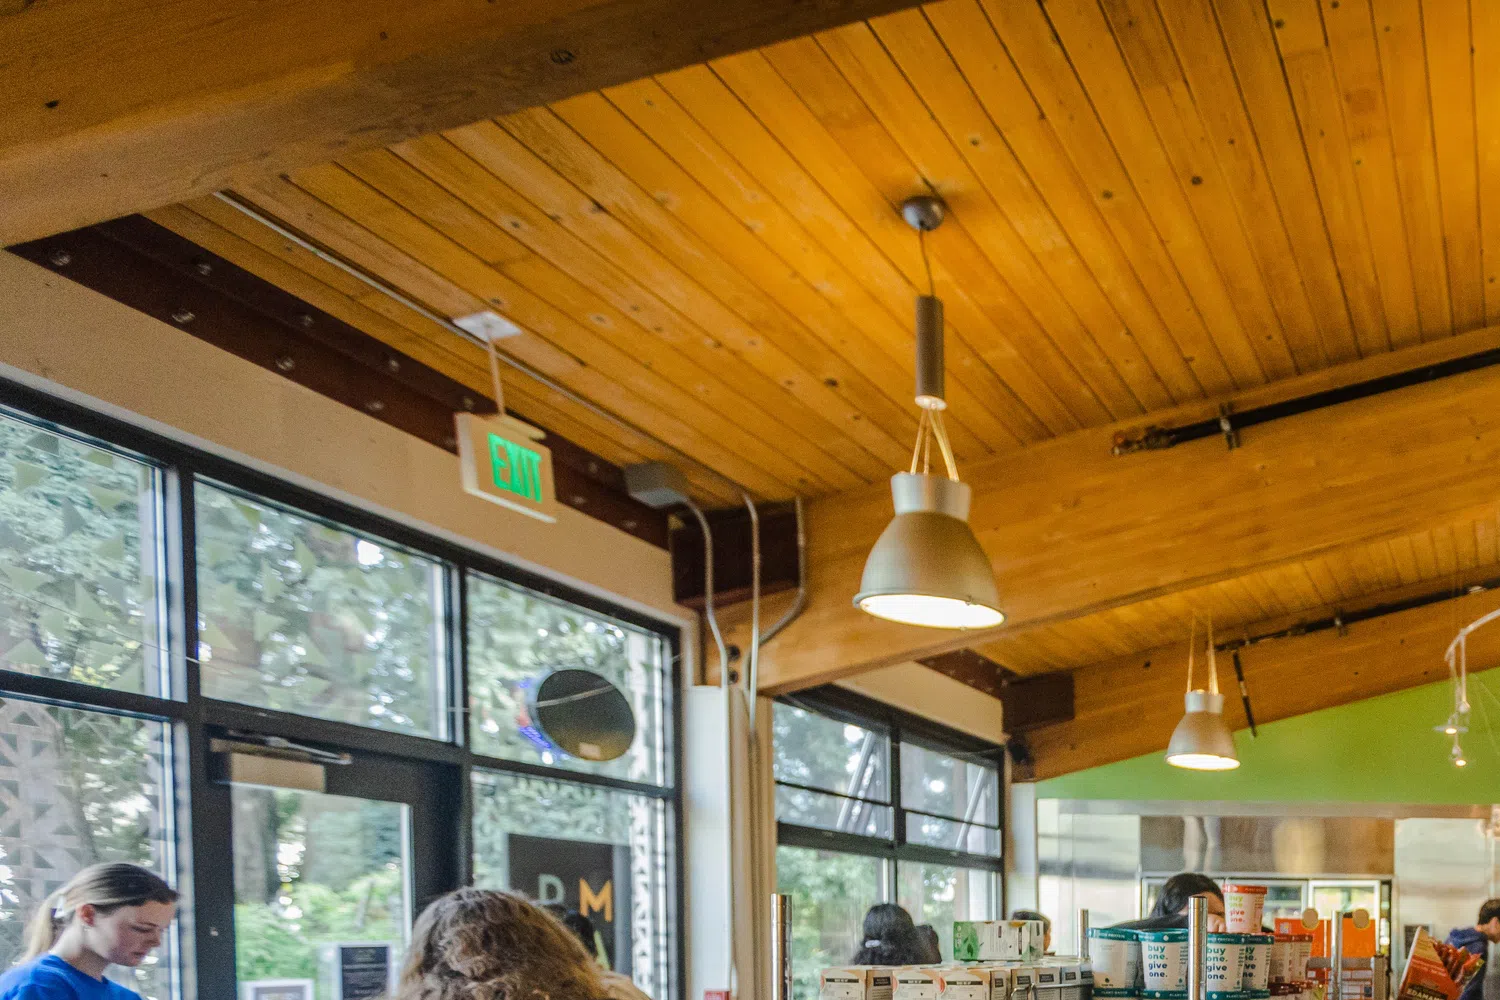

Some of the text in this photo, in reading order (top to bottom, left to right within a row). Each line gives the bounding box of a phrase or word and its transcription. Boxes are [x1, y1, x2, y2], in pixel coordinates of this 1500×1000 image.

[488, 432, 542, 503] EXIT
[1148, 945, 1166, 953] buy
[1207, 947, 1226, 955] buy
[1148, 962, 1168, 970] give
[1207, 964, 1227, 972] give
